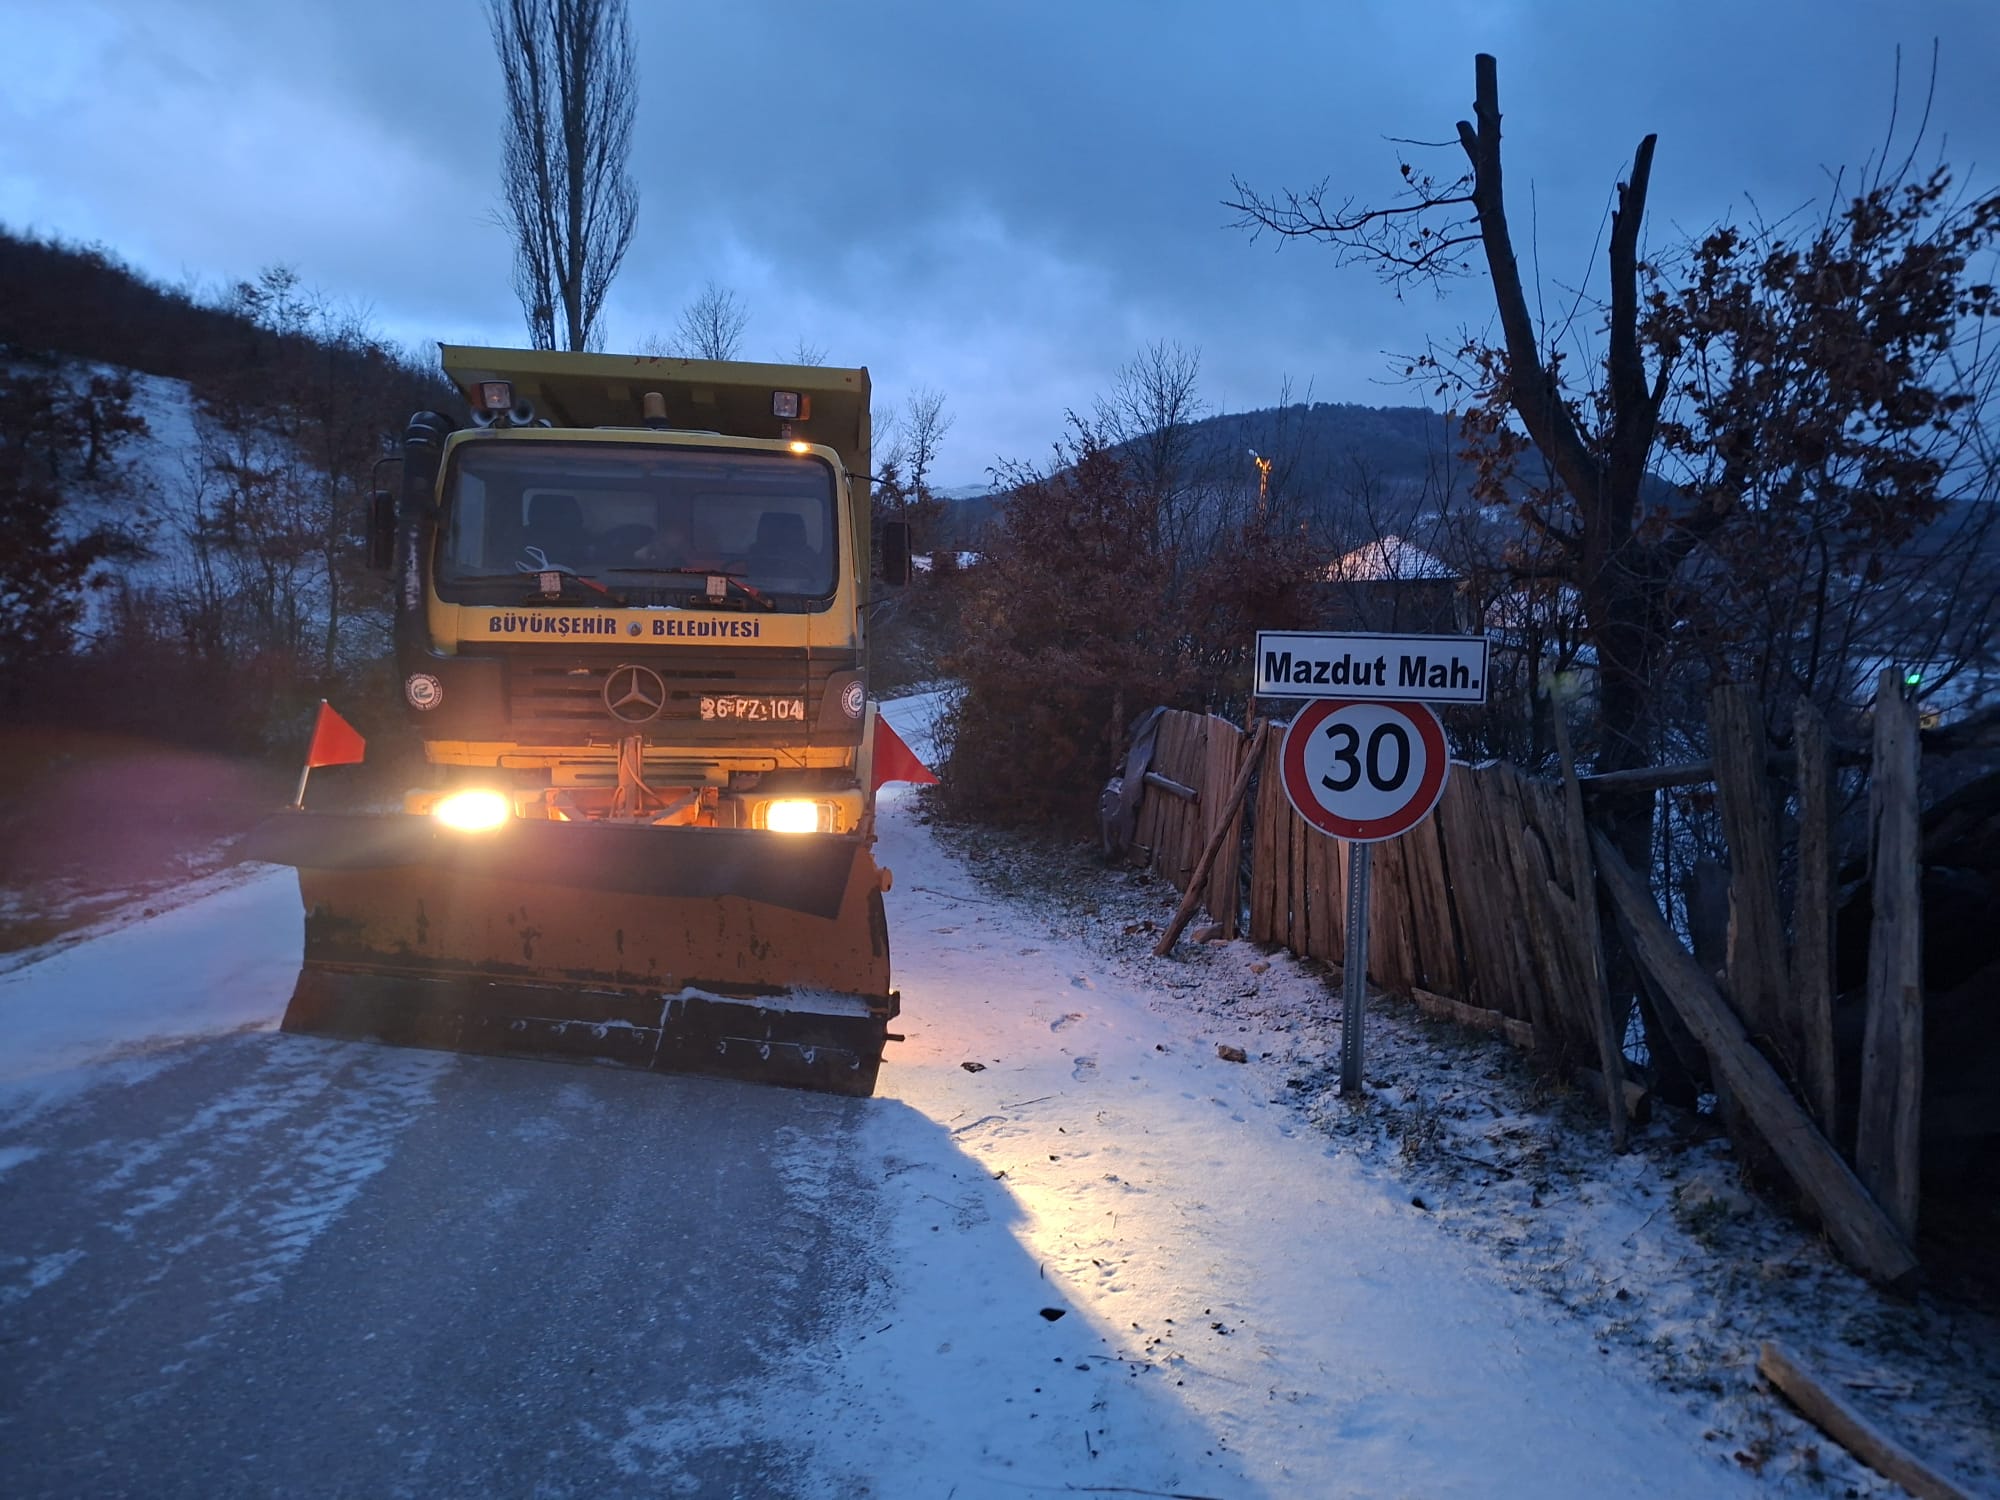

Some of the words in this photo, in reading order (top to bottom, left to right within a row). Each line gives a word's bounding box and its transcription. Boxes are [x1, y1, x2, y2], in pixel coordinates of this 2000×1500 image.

[489, 612, 617, 637] BÜYÜKŞEHİR
[652, 617, 760, 638] BELEDİYESİ
[1264, 651, 1387, 687] Mazdut
[1398, 655, 1480, 690] Mah.
[770, 699, 803, 719] 104
[1321, 722, 1411, 792] 30
